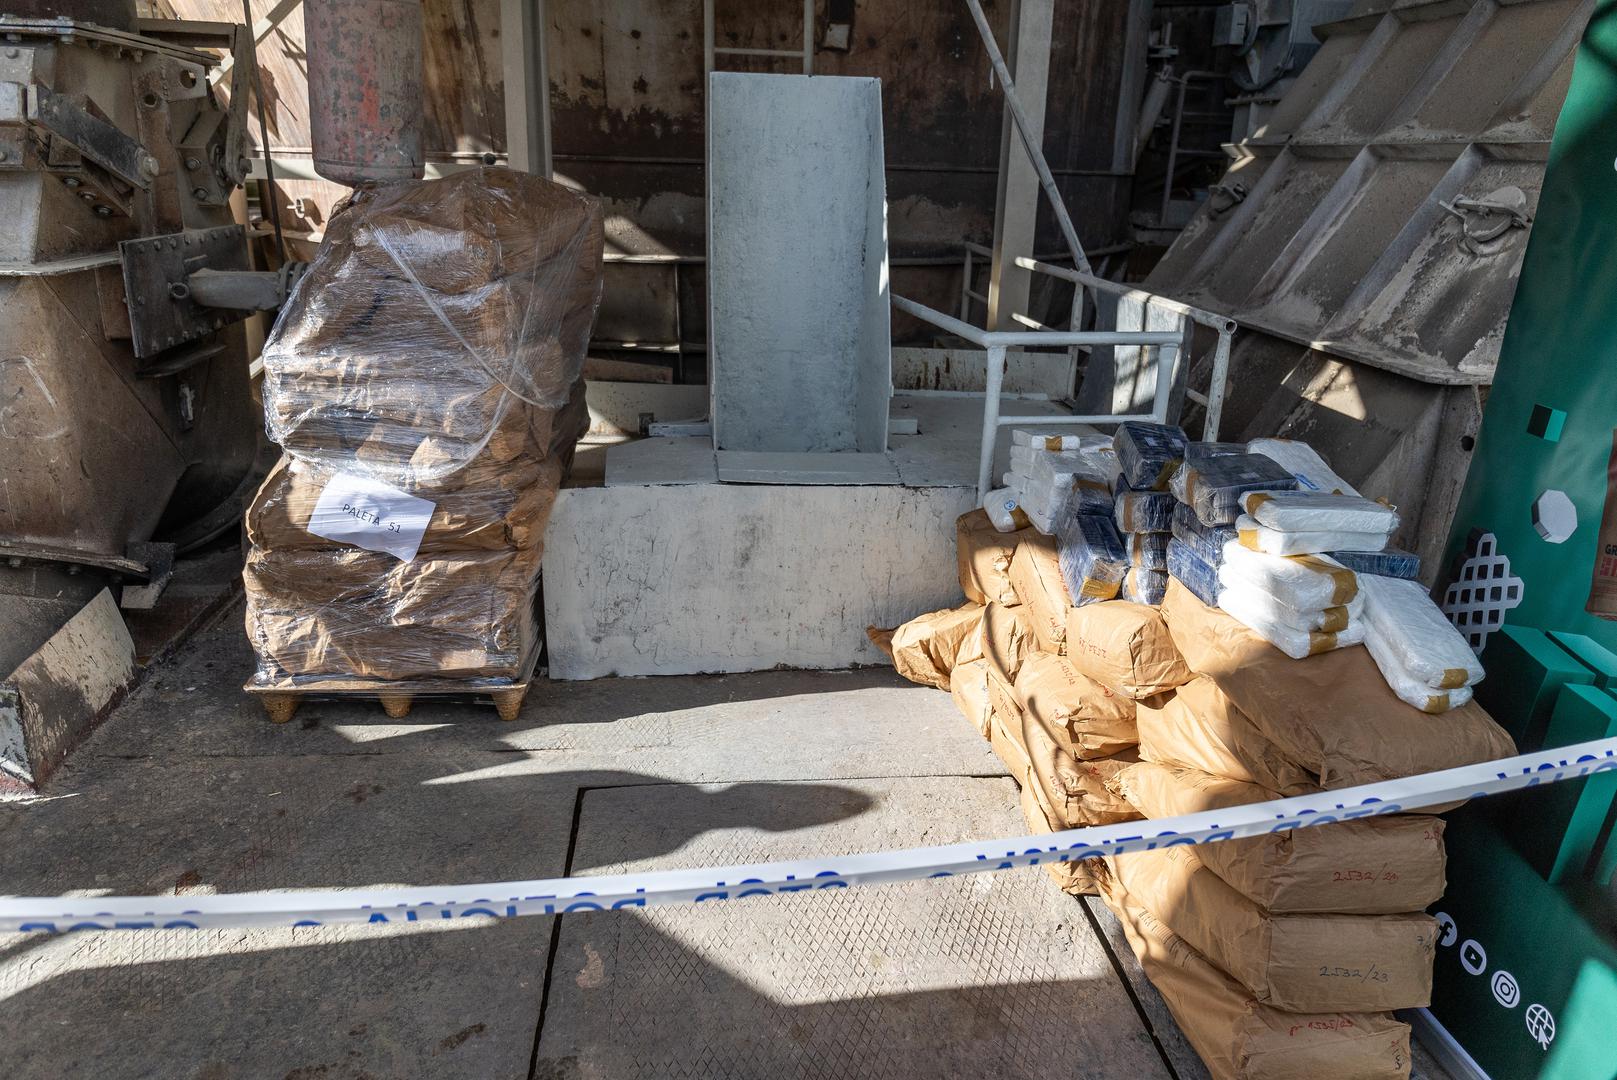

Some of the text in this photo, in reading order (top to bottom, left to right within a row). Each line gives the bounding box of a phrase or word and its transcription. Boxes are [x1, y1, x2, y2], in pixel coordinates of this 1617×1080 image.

[342, 503, 401, 534] PALETA 51
[1320, 963, 1389, 984] 2532/23
